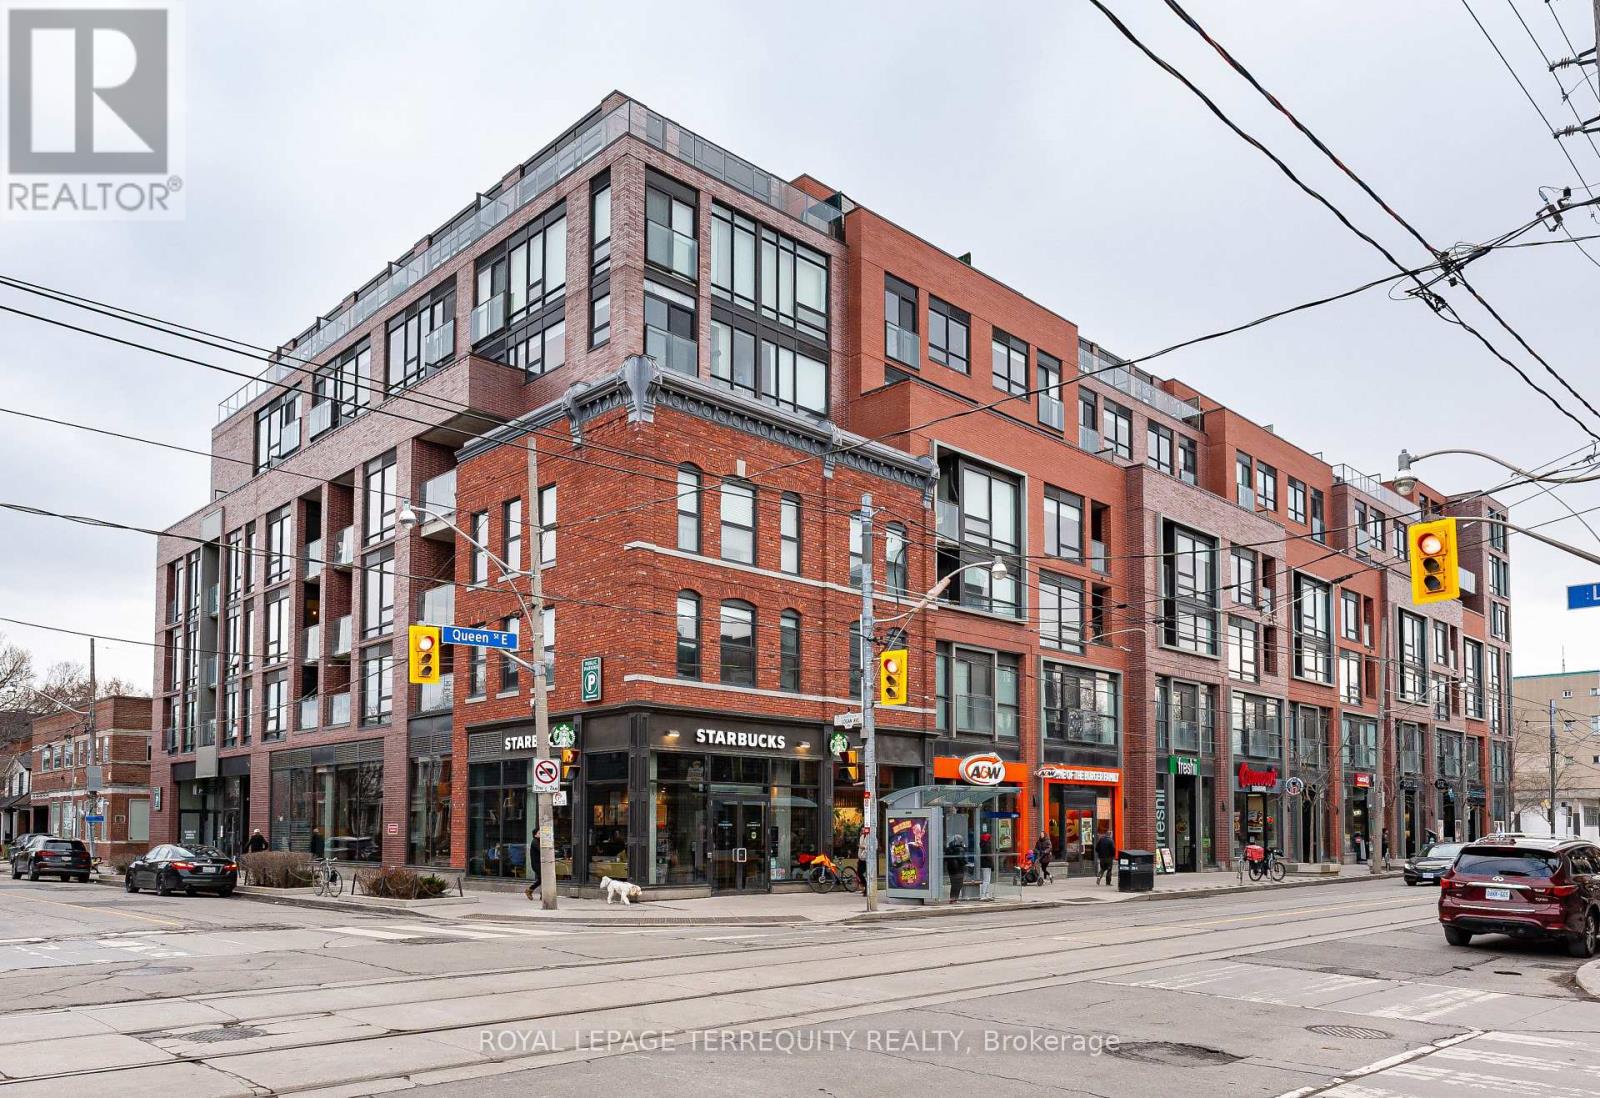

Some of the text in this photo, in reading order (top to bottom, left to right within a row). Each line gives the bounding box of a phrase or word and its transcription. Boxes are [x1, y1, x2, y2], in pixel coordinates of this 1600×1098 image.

[452, 629, 489, 644] Queen
[501, 634, 508, 645] E
[587, 673, 596, 691] P
[696, 728, 786, 749] STARBUCKS
[970, 765, 1001, 780] A&W
